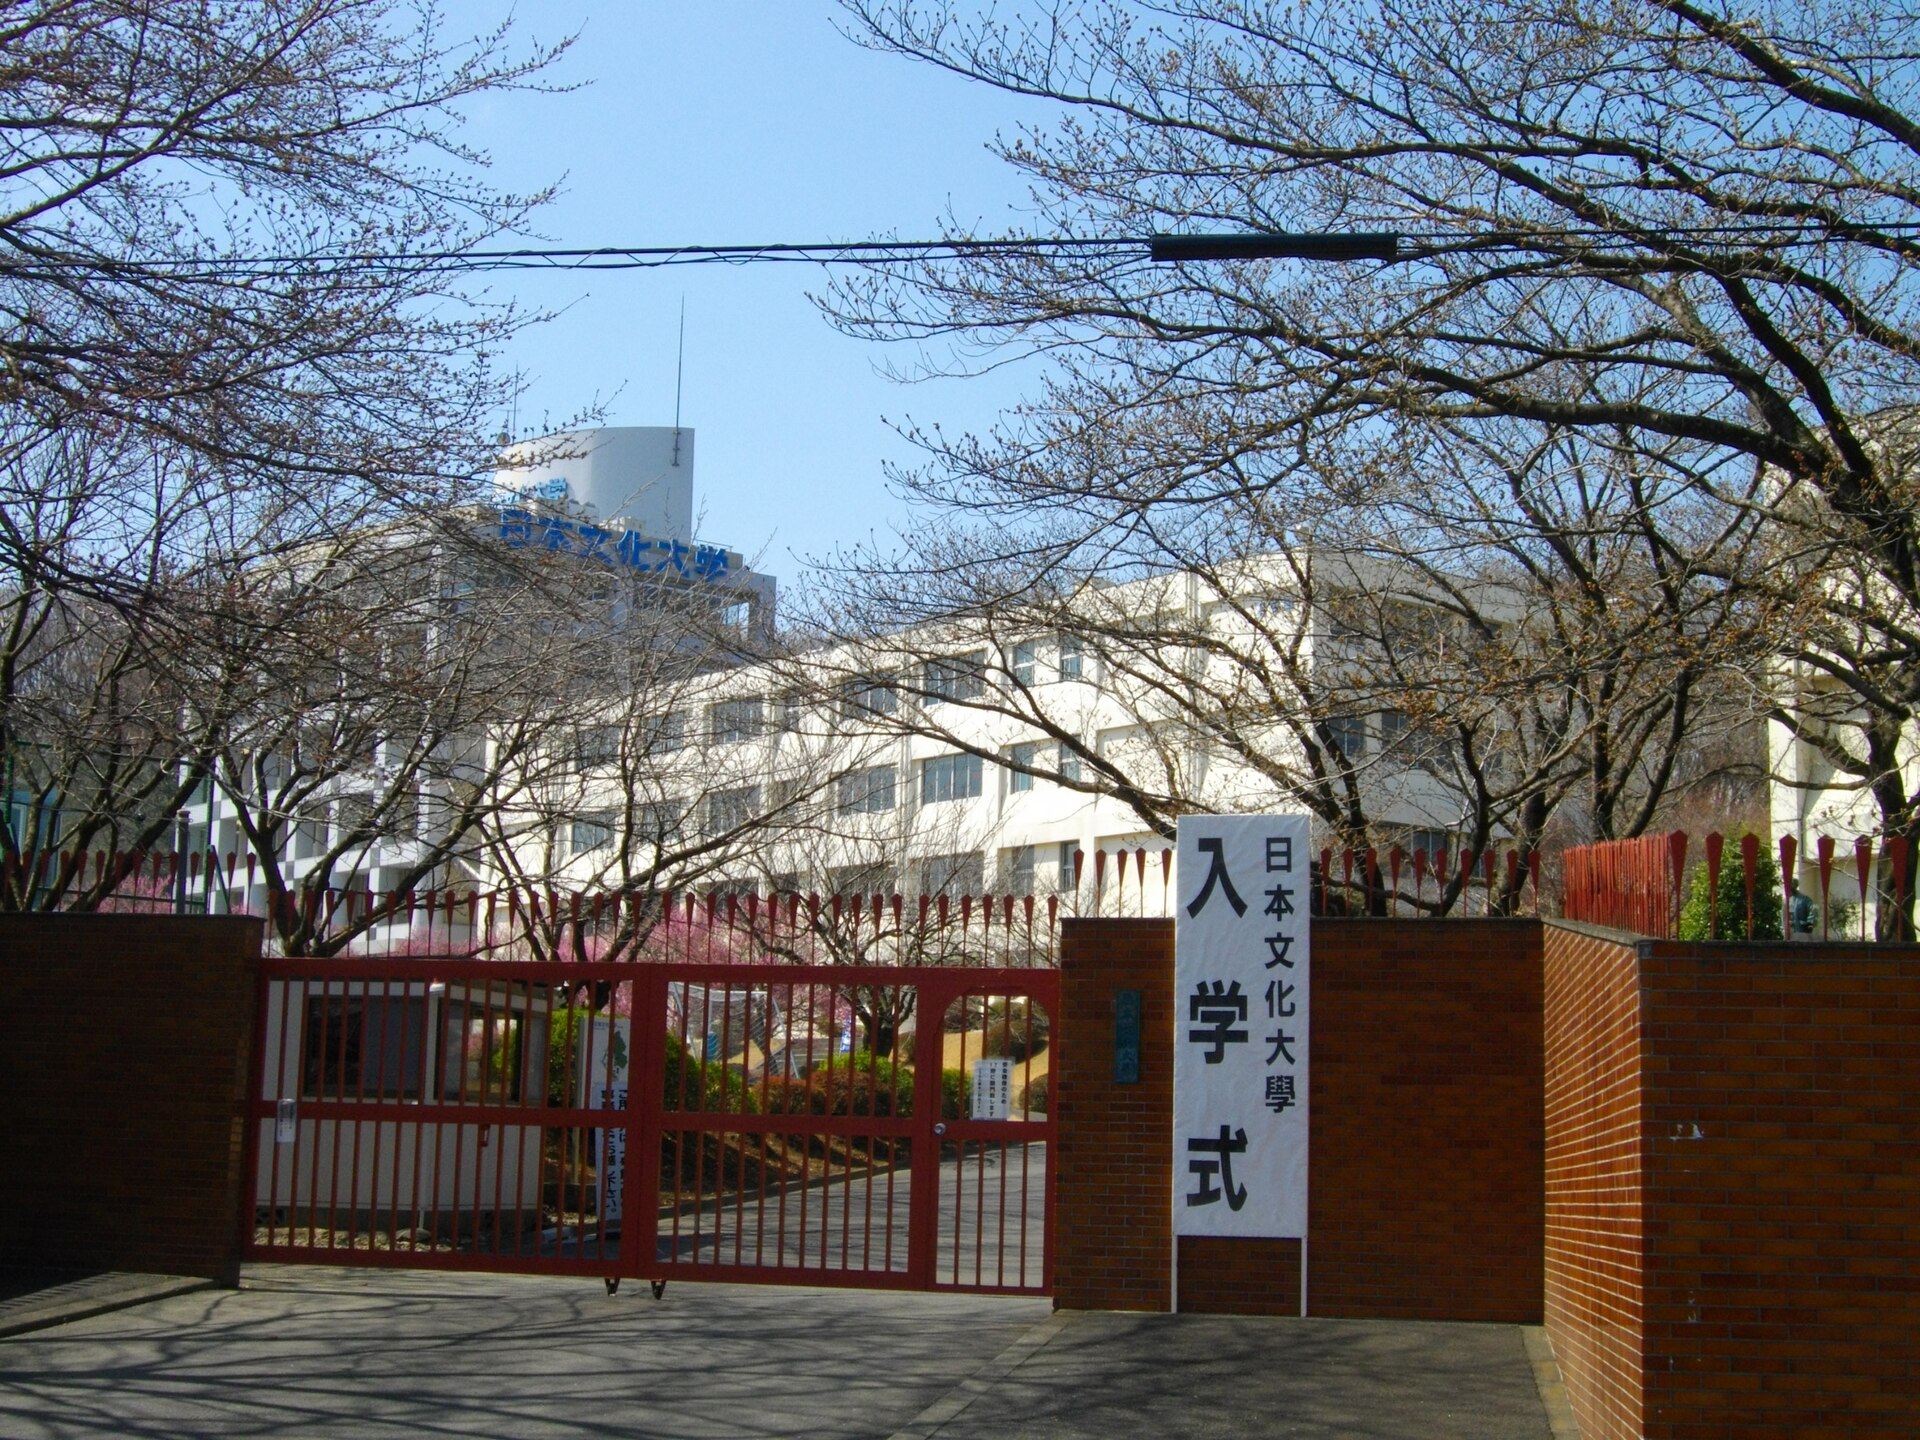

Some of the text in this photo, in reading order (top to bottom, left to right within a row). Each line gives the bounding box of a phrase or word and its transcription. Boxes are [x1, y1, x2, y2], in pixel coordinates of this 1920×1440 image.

[1186, 837, 1249, 1212] 入学式
[1264, 837, 1296, 1114] 日本文化大學
